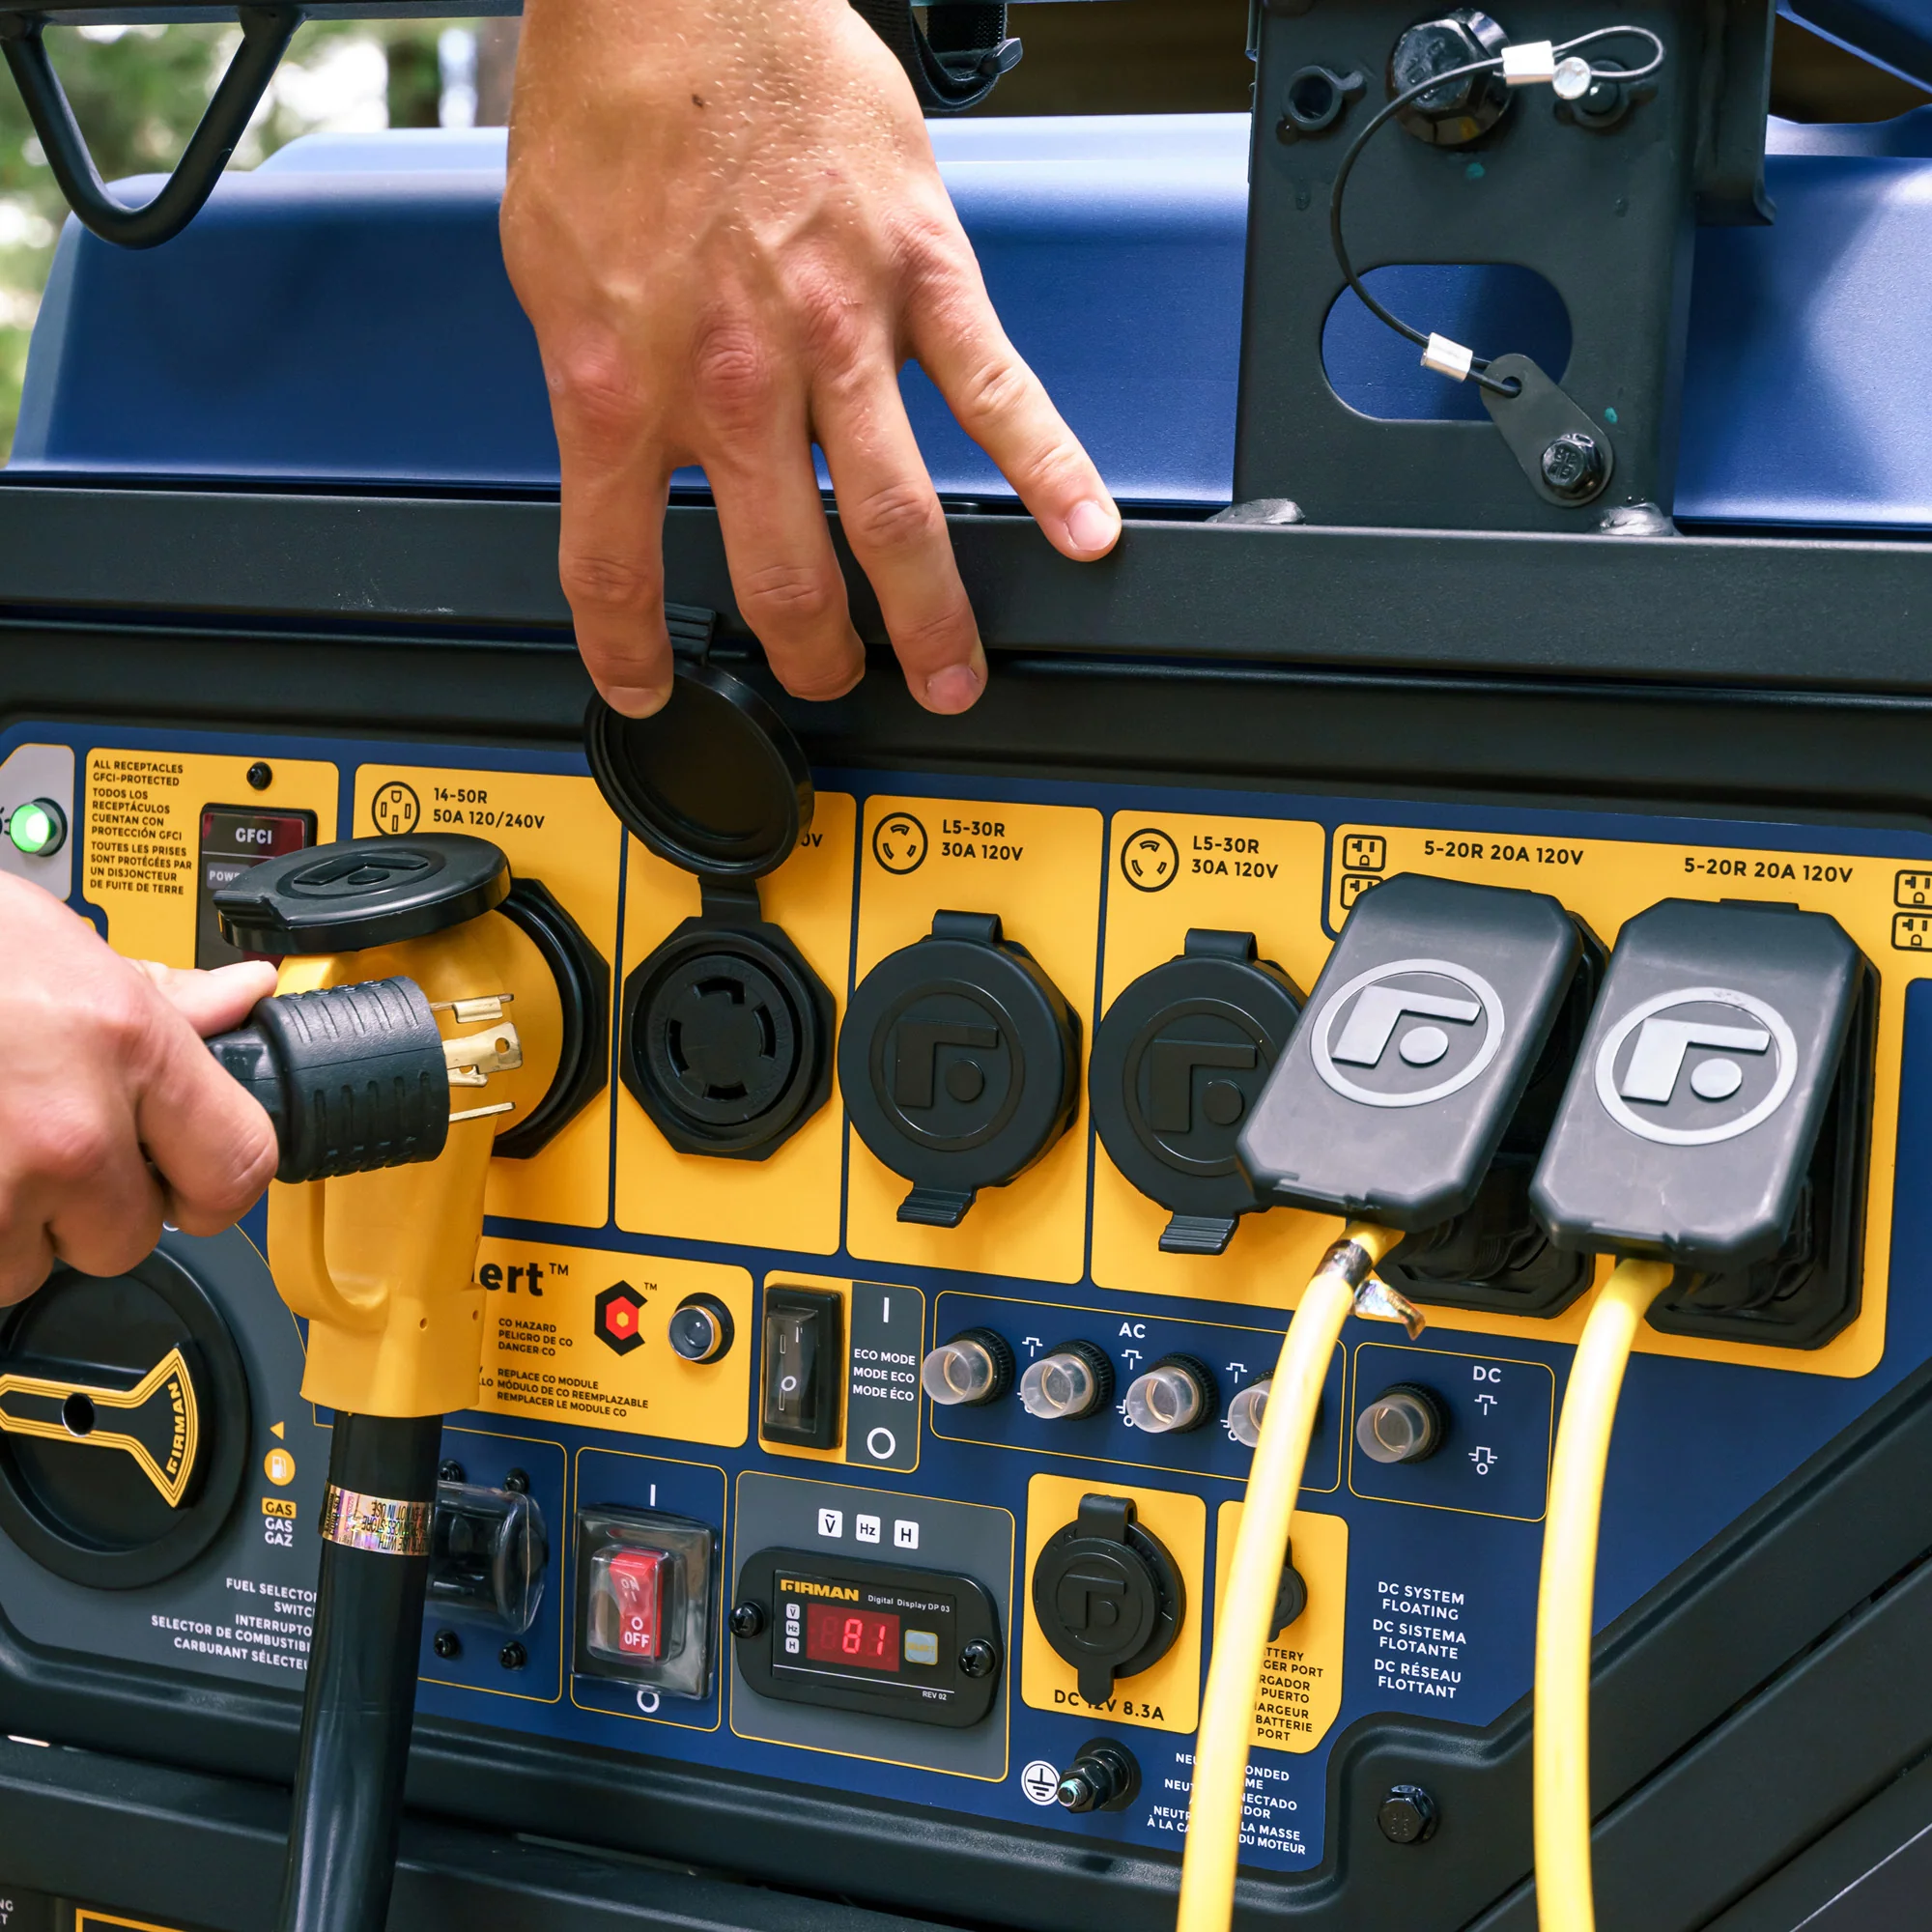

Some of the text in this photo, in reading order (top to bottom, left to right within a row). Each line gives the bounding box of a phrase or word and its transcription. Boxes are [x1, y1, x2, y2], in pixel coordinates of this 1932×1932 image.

[94, 760, 184, 774] ALL RECEPTACLES
[94, 773, 180, 786] GFCI-PROTECTED
[93, 788, 148, 800] TODOS LOS
[435, 787, 488, 804] 14-50R
[92, 799, 170, 814] RECEPTÁCULOS
[92, 813, 164, 827] CUENTAN CON
[433, 809, 545, 829] 50A 120/240V
[92, 827, 183, 841] PROTECCIÓN GFCI
[235, 828, 272, 844] GFCI
[943, 819, 1005, 838] L5-30R
[91, 841, 186, 857] TOUTES LES PRISES
[942, 841, 1023, 861] 30A 120V
[1193, 836, 1260, 854] L5-30R
[1424, 840, 1584, 866] 5-20R 20A 120V
[91, 853, 192, 870] SONT PROTÉGÉES PAR
[1191, 858, 1279, 879] 30A 120V
[1684, 857, 1854, 883] 5-20R 20A 120V
[90, 867, 177, 882] UN DISJONCTEUR
[90, 879, 184, 895] DE FUITE DE TERRE
[479, 1260, 544, 1297] ert
[498, 1318, 557, 1333] CO HAZARD
[1119, 1321, 1146, 1339] AC
[498, 1330, 573, 1348] PELIGRO DE CO
[497, 1342, 556, 1356] DANGER CO
[854, 1349, 916, 1366] ECO MODE
[497, 1368, 541, 1382] REPLACE
[542, 1374, 556, 1384] CO
[558, 1376, 599, 1390] MODULE
[853, 1367, 915, 1383] MODE ECO
[1472, 1365, 1502, 1383] DC
[497, 1378, 649, 1409] MÓDULO DE CO REEMPLAZABLE
[852, 1384, 915, 1402] MODE ÉCO
[497, 1391, 627, 1417] REMPLACER LE MODULE CO
[166, 1381, 187, 1475] FIRMAN
[265, 1500, 293, 1516] GAS
[265, 1518, 293, 1532] GAS
[860, 1522, 876, 1537] Hz
[900, 1527, 912, 1543] H
[265, 1531, 294, 1548] GAZ
[226, 1577, 256, 1593] FUEL
[780, 1578, 860, 1603] FIRMAN
[1378, 1581, 1464, 1605] DC SYSTEM
[867, 1594, 951, 1613] Digital Display DP 03
[1382, 1598, 1459, 1621] FLOATING
[151, 1615, 213, 1635] SELECTOR
[215, 1626, 232, 1639] DE
[236, 1614, 313, 1637] INTERRUPTO
[787, 1624, 798, 1634] Hz
[1373, 1619, 1467, 1645] DC SISTEMA
[624, 1631, 650, 1648] OFF
[841, 1618, 887, 1656] 81
[174, 1636, 248, 1660] CARBURANT
[1264, 1647, 1304, 1662] TTERY
[1379, 1635, 1459, 1660] FLOTANTE
[1263, 1660, 1323, 1678] GER PORT
[1374, 1659, 1462, 1683] DC RÉSEAU
[1259, 1674, 1311, 1691] RGADOR
[1378, 1675, 1457, 1699] FLOTTANT
[922, 1690, 948, 1701] REV 02
[1261, 1687, 1310, 1704] PUERTO
[1054, 1689, 1079, 1707] DC
[1122, 1701, 1165, 1721] 8.3A
[1255, 1701, 1309, 1719] ARGEUR
[1255, 1714, 1313, 1733] BATTERIE
[1257, 1727, 1291, 1742] PORT
[1244, 1765, 1290, 1782] ONDED
[1244, 1777, 1264, 1790] ME
[1241, 1792, 1297, 1811] NECTADO
[1240, 1804, 1271, 1820] IDOR
[1153, 1804, 1300, 1841] NEUTR LA MASSE
[1147, 1814, 1306, 1856] À LA CA DU MOTEUR
